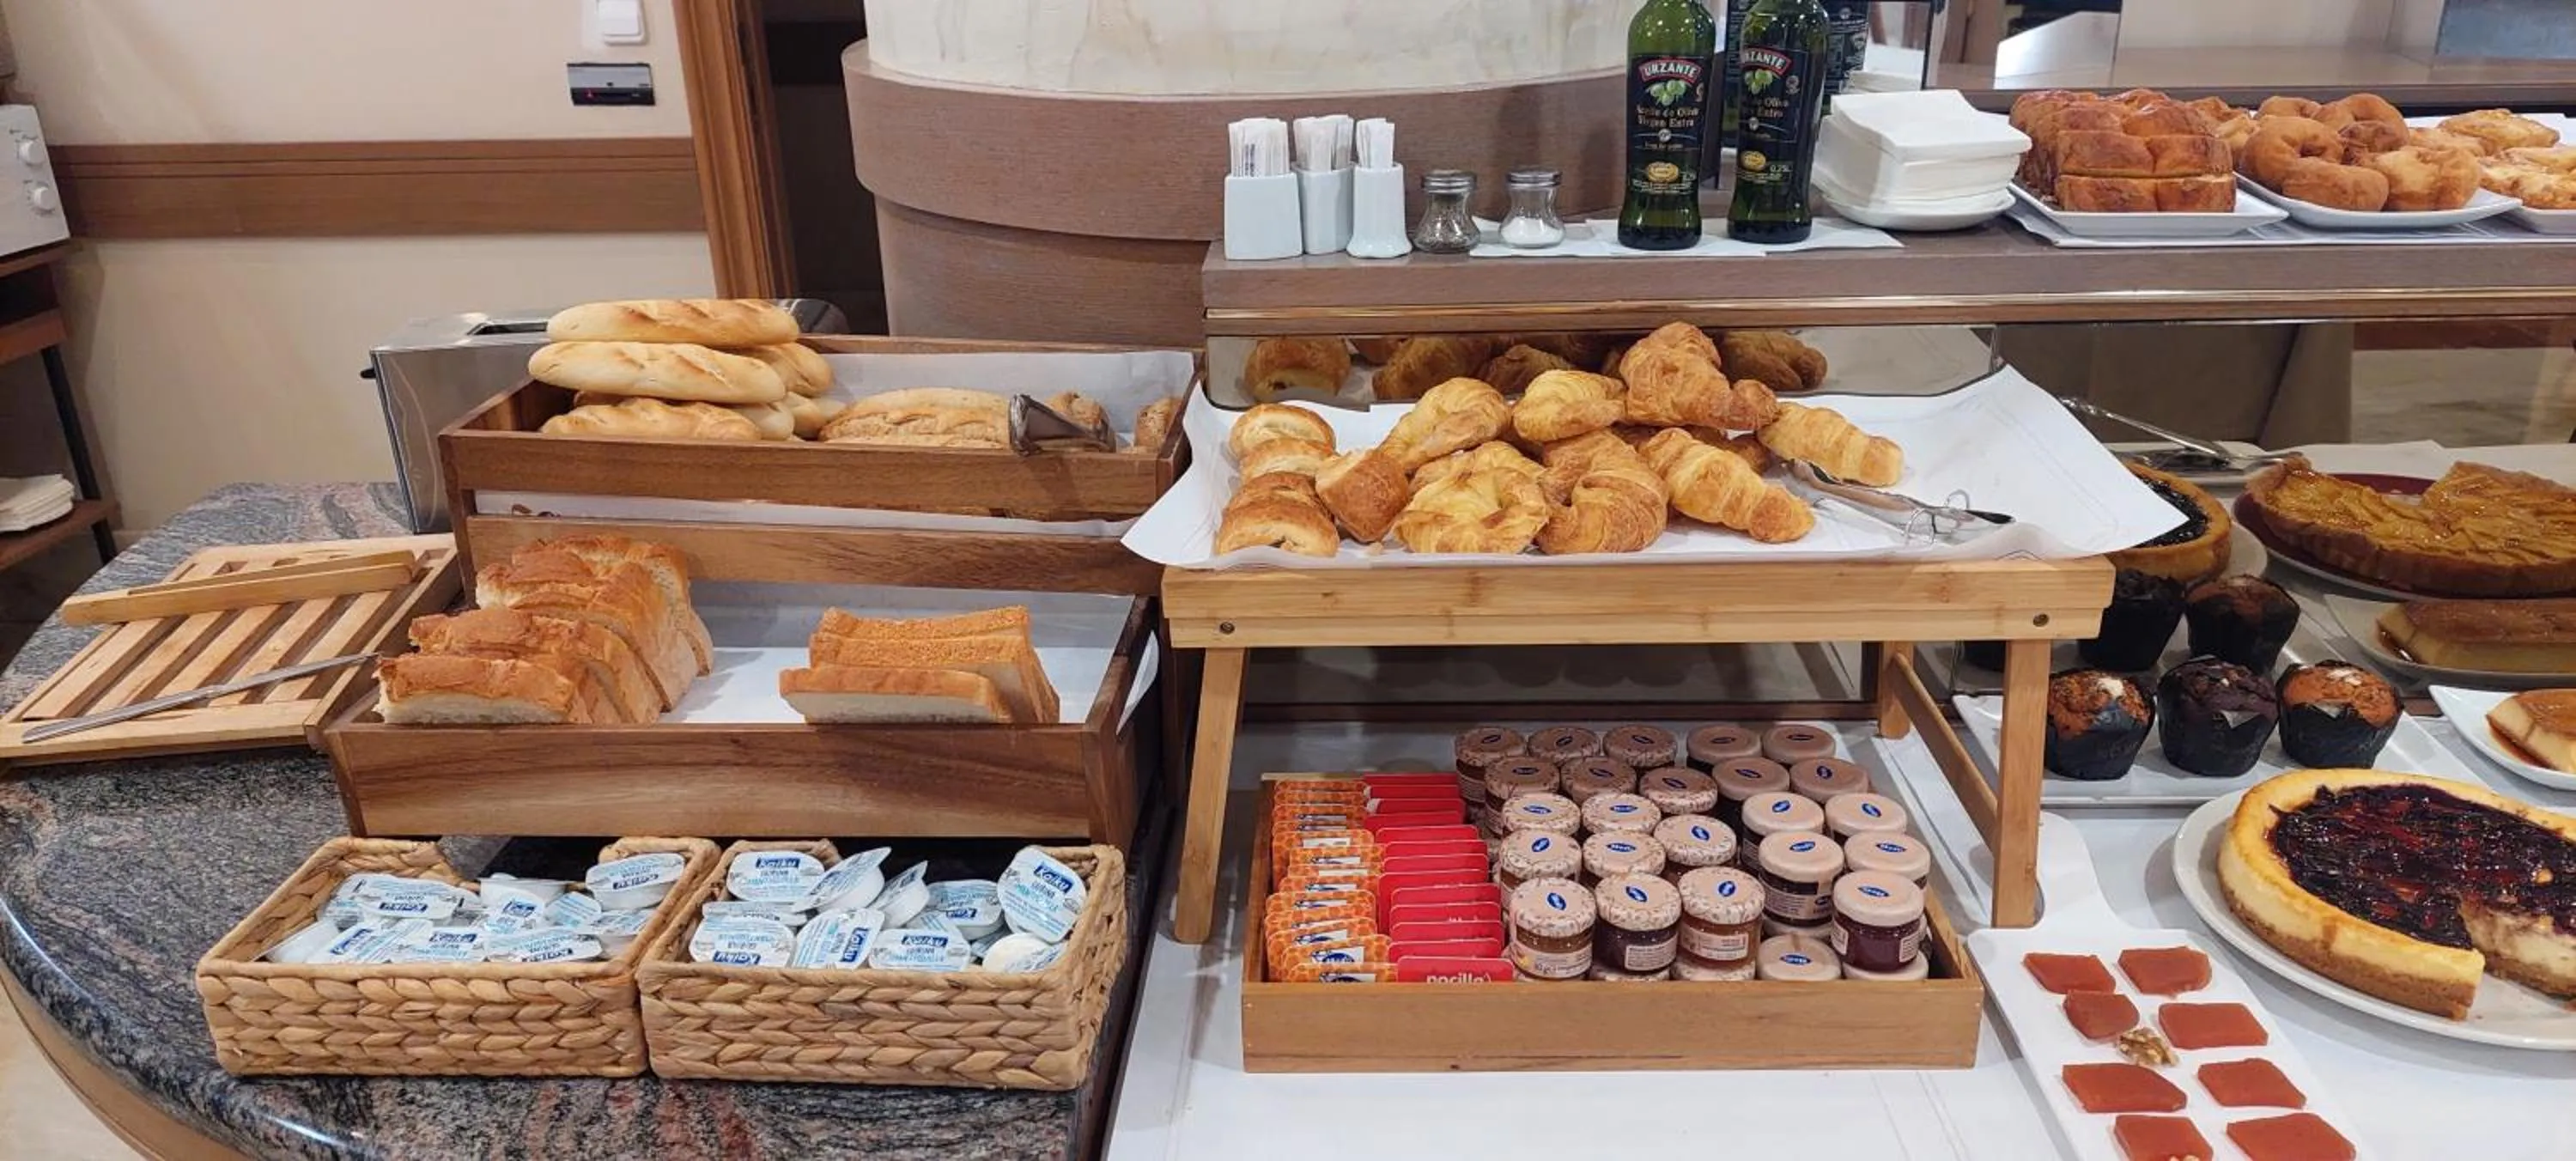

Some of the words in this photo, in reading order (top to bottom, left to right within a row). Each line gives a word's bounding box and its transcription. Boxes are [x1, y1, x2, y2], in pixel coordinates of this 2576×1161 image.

[1644, 62, 1698, 77] URZANTE
[1036, 865, 1070, 892] Kaiku
[714, 951, 758, 963] Kaiku
